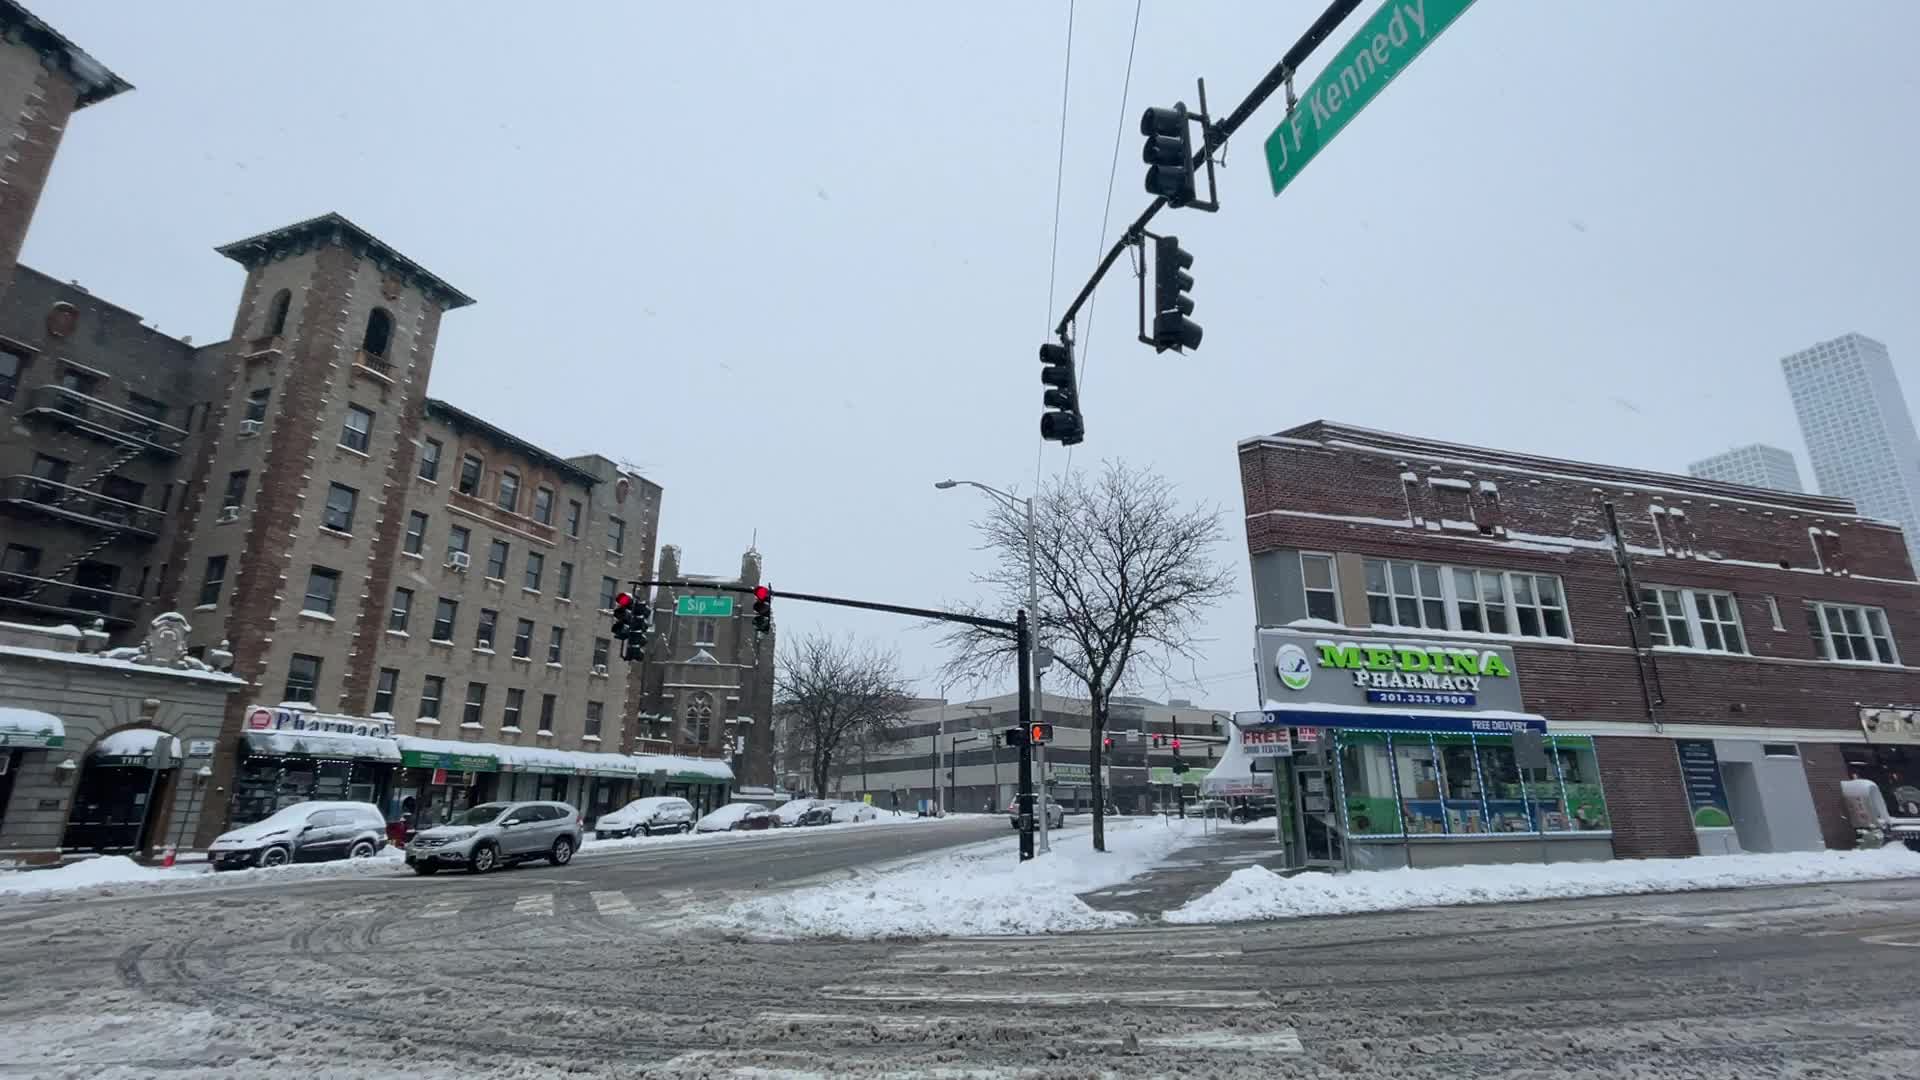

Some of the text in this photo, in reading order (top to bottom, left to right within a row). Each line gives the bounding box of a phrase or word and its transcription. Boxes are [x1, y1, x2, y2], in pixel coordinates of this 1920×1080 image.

[1278, 0, 1426, 171] J F Kennedy
[687, 600, 707, 613] Sip
[1317, 643, 1512, 677] MEDINA
[1353, 670, 1481, 692] PHARMACY
[1379, 692, 1467, 705] 201.333.9900
[1471, 720, 1528, 732] FREE DELIVERY
[1243, 728, 1289, 745] FREE
